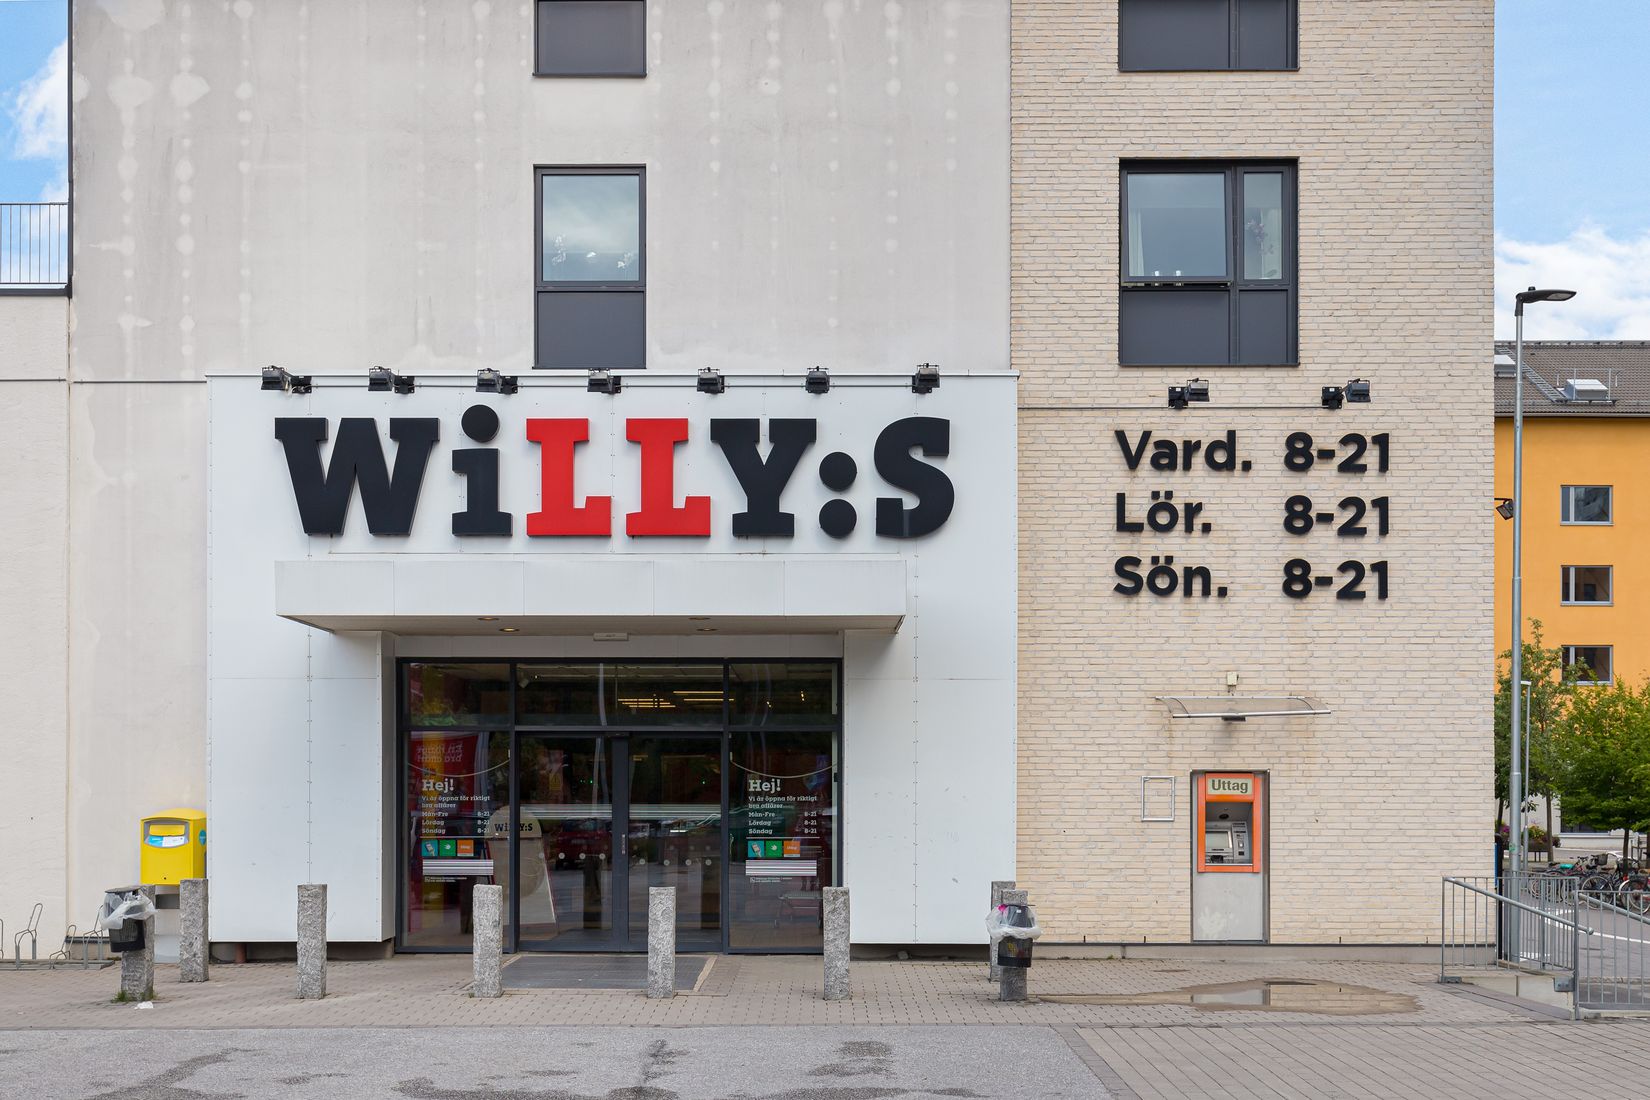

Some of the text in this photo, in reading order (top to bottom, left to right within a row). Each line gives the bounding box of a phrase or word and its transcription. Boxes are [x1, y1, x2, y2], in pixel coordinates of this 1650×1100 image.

[275, 404, 955, 539] WiLLY:S
[1114, 430, 1389, 472] Vard. 8-21
[1116, 490, 1389, 535] Lör. 8-21
[1113, 555, 1388, 599] Sön. 8-21
[422, 778, 454, 793] Hej!
[748, 778, 781, 793] Hej!
[1211, 779, 1248, 793] Uttag
